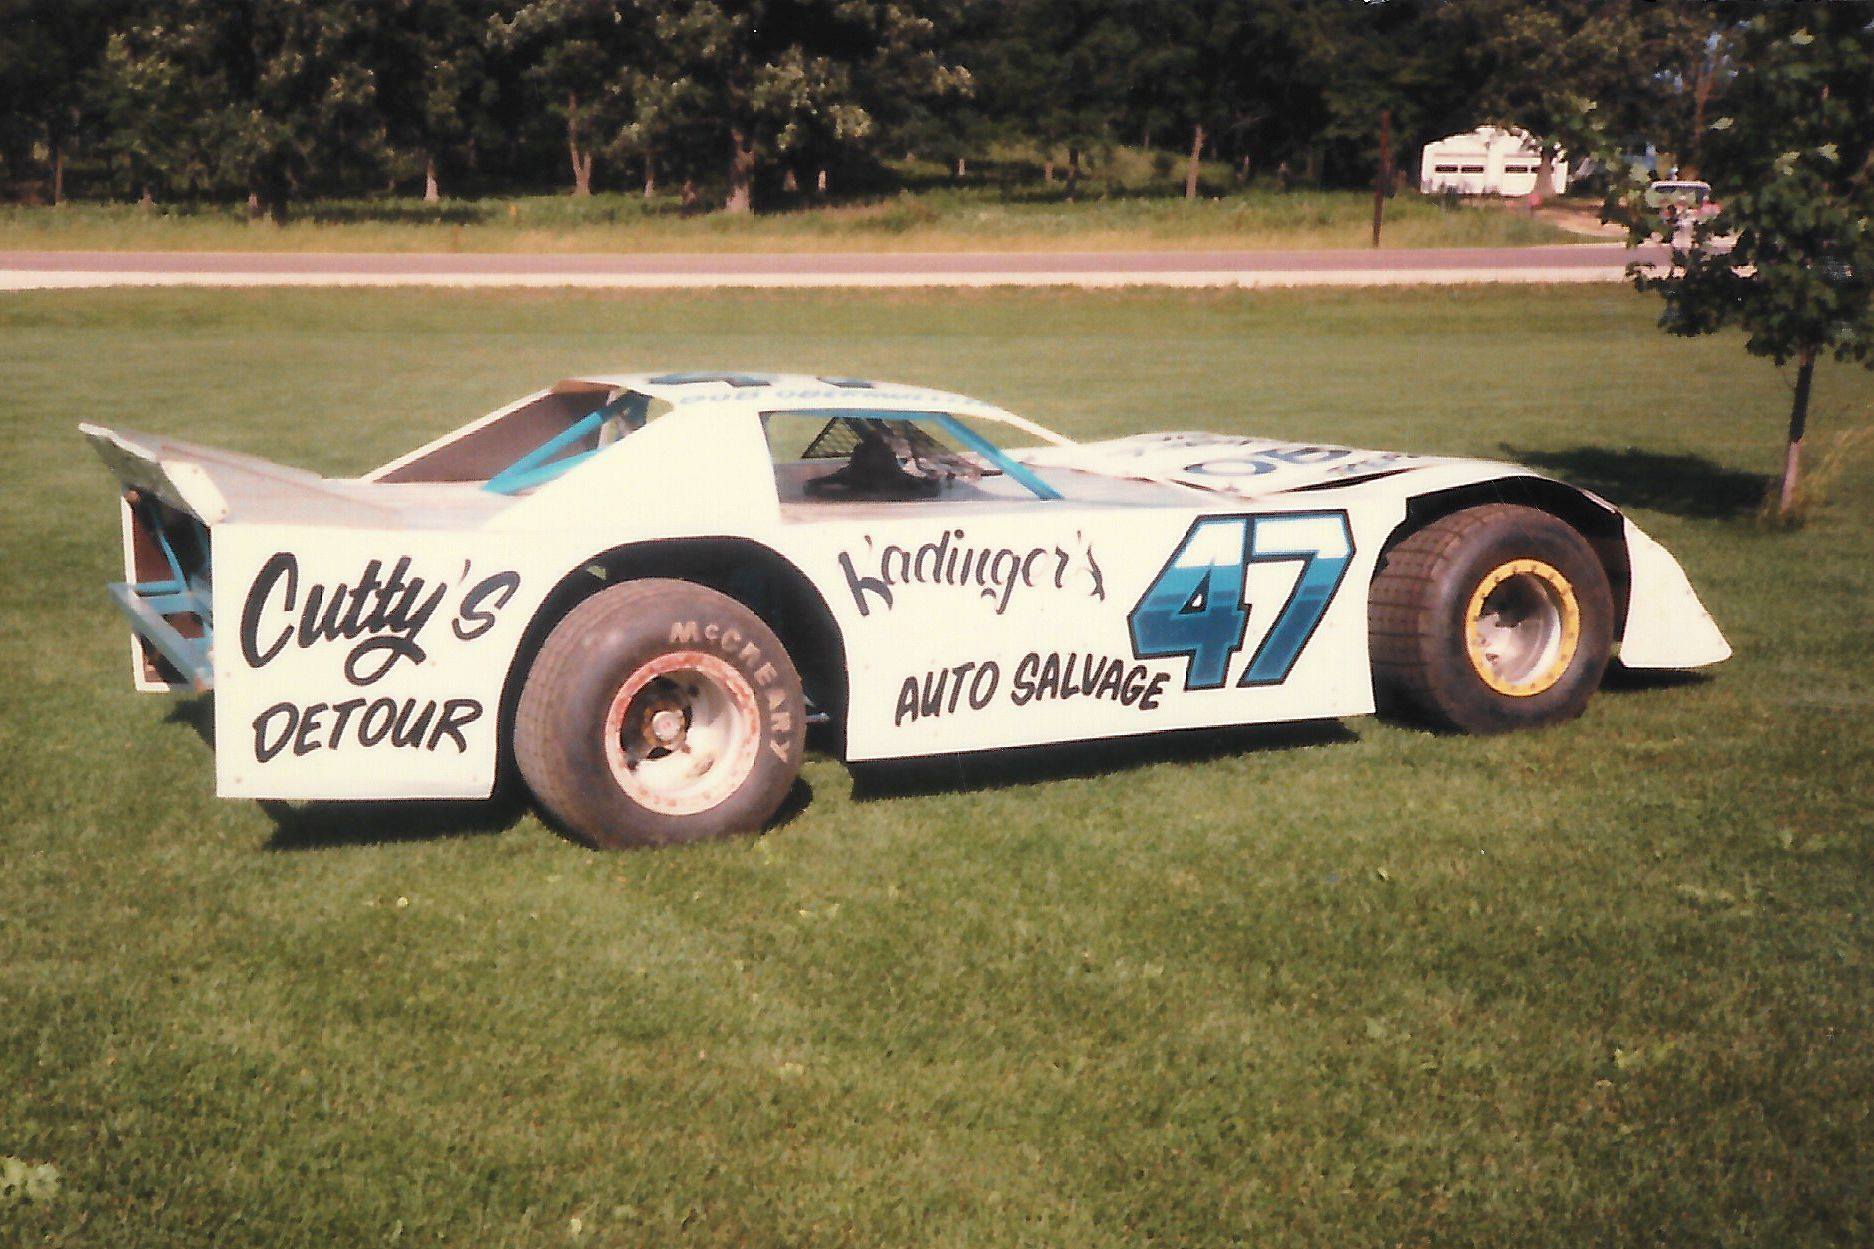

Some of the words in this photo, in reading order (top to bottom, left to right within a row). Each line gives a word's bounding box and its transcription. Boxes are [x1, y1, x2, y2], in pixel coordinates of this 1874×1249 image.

[239, 551, 522, 686] Cutty's
[1126, 508, 1357, 691] 47
[252, 696, 483, 764] DETOUR
[894, 660, 1000, 728] AUTO
[1010, 652, 1172, 711] SALVAGE
